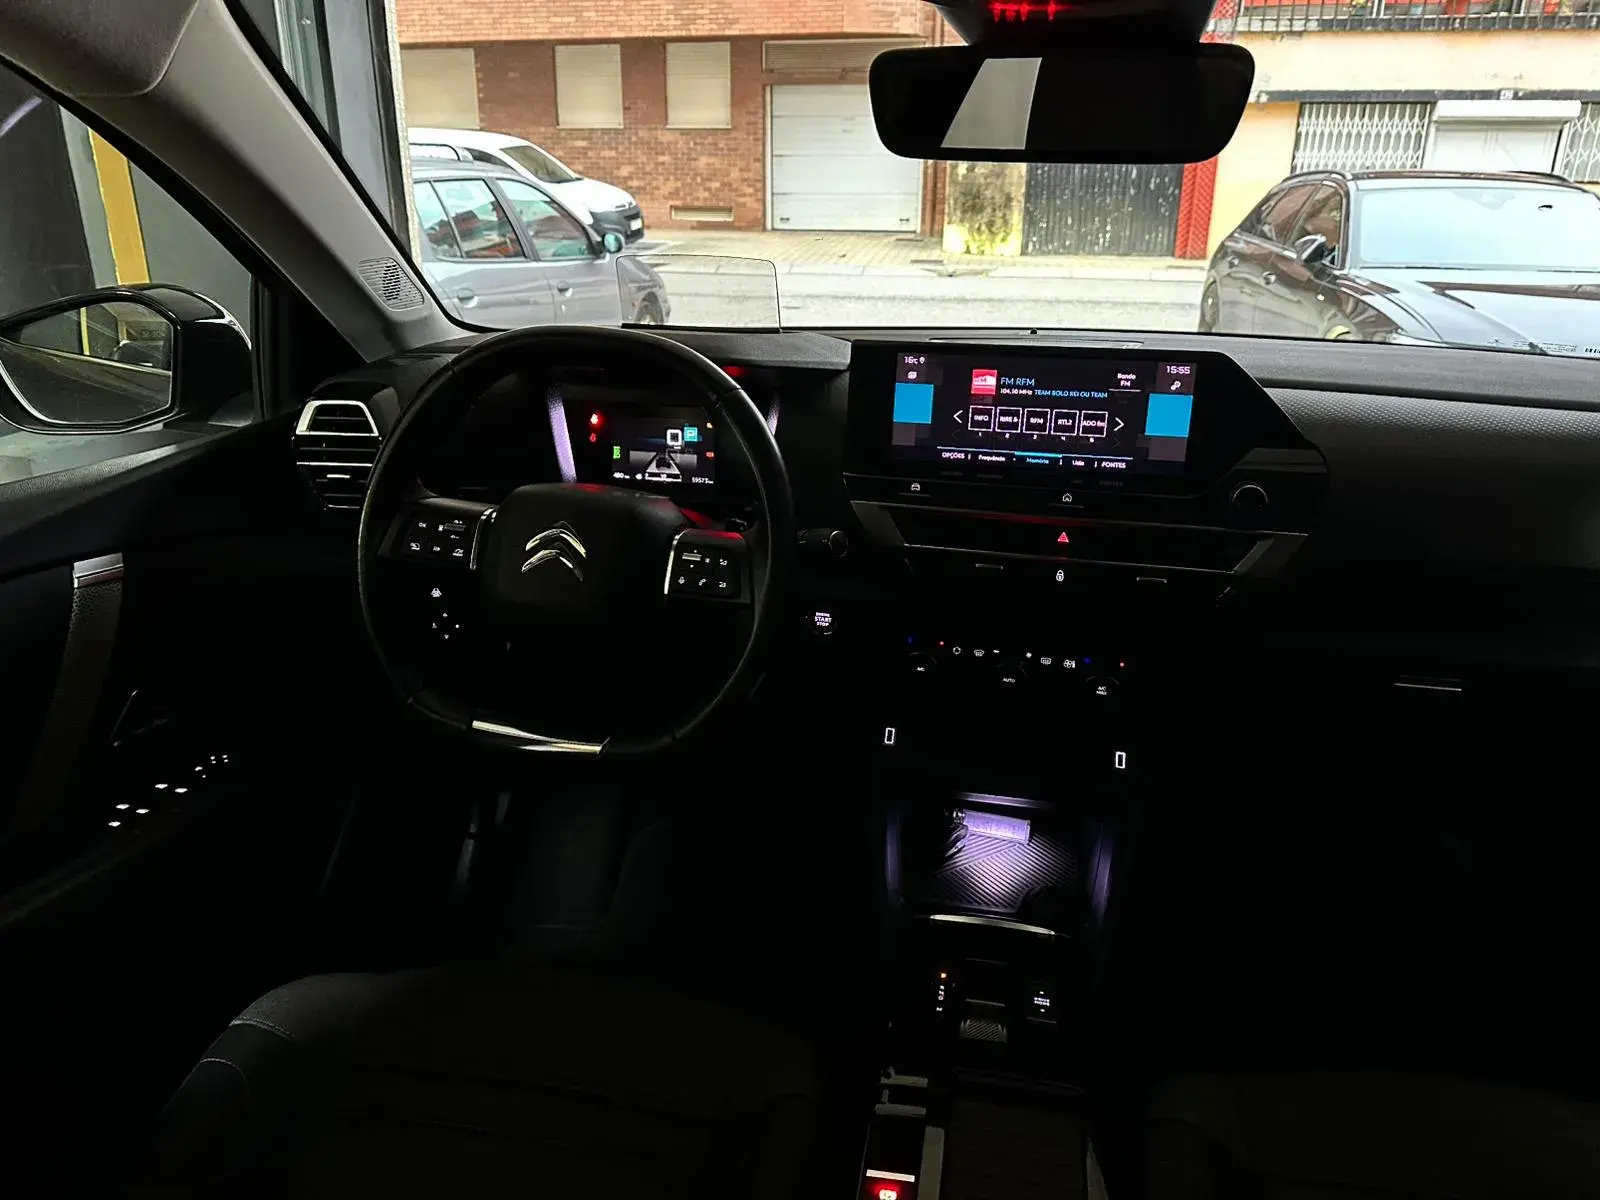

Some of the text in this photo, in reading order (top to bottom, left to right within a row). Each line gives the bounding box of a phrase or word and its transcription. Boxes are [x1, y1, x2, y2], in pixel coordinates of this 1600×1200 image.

[1165, 365, 1191, 375] 15:55
[1000, 376, 1035, 387] FM RFM
[973, 414, 990, 422] INFO
[1101, 461, 1127, 469] FONTES
